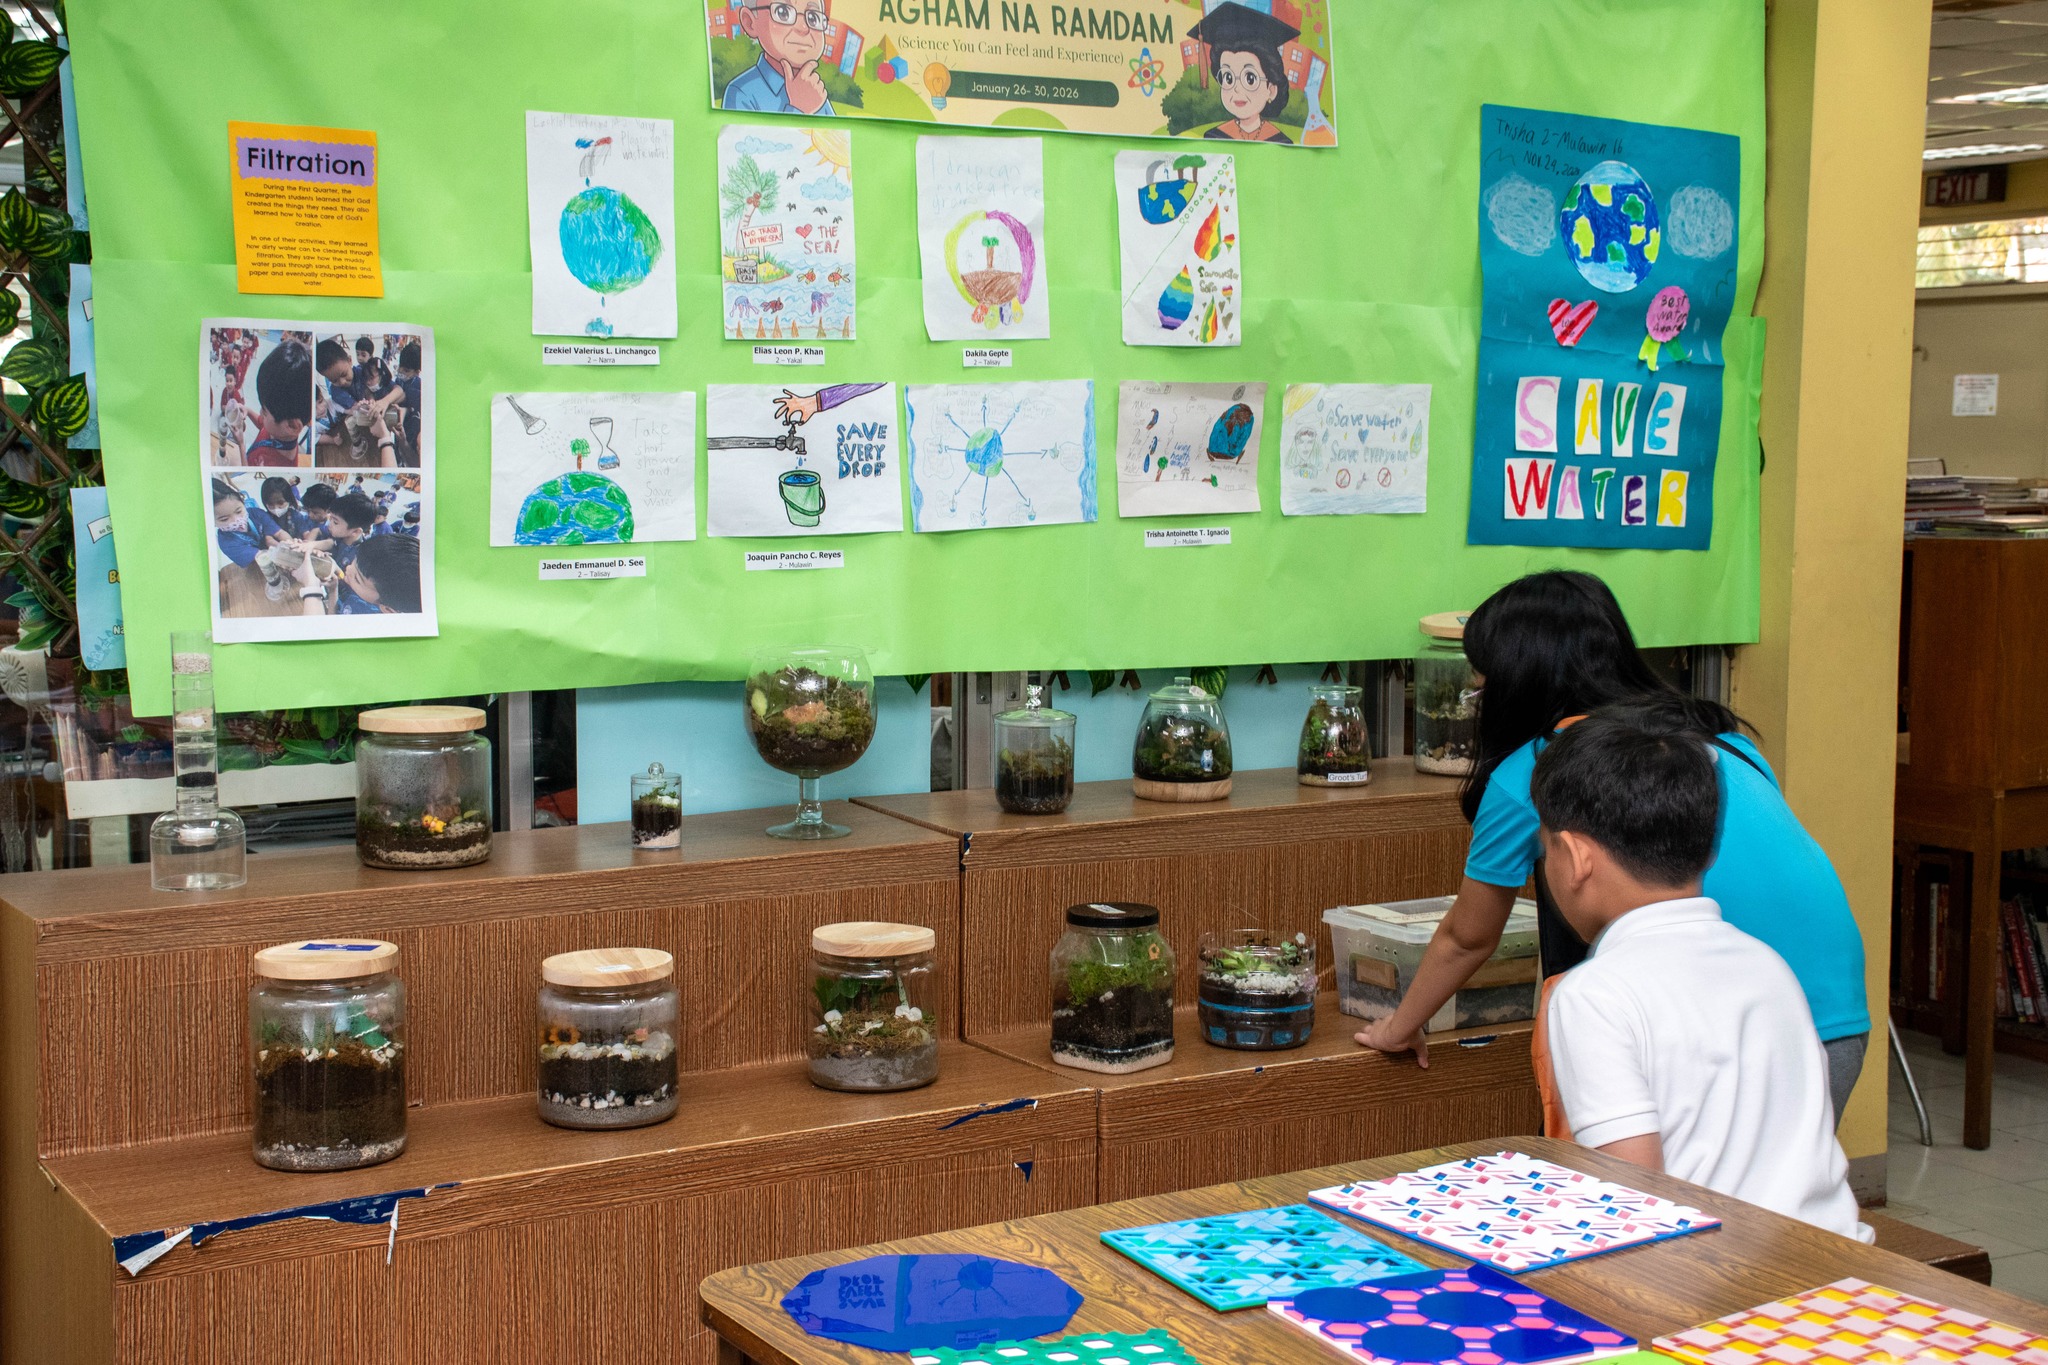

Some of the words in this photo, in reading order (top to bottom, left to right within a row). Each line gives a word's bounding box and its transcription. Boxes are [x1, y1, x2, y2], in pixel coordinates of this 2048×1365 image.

[879, 0, 990, 30] AGHAM
[1002, 2, 1040, 34] NA
[1053, 7, 1174, 44] RAMDAM
[898, 35, 950, 51] (Science
[952, 40, 975, 53] You
[978, 42, 1002, 55] Can
[1006, 43, 1029, 58] Feel
[1032, 46, 1054, 59] and
[1058, 48, 1124, 66] Experience)
[972, 82, 1010, 97] January
[1014, 84, 1030, 95] 26-
[1034, 86, 1050, 98] 30,
[1054, 86, 1079, 98] 2026
[1496, 118, 1535, 144] Trisha
[248, 147, 365, 176] Filtration
[1936, 173, 1980, 205] EXIT
[744, 230, 755, 238] NO
[818, 225, 838, 238] THE
[804, 240, 839, 255] SEA!
[1661, 294, 1686, 308] Best
[1653, 321, 1684, 332] Award
[615, 348, 656, 356] Linchangco
[989, 350, 1008, 358] Gepte
[1334, 403, 1364, 428] Save
[1366, 412, 1402, 430] water
[1518, 378, 1674, 451] SAVE
[632, 418, 671, 438] Take
[837, 422, 888, 442] SAVE
[837, 442, 885, 461] EVERY
[1330, 440, 1359, 463] Save
[649, 467, 669, 476] and
[839, 461, 886, 479] DROP
[1507, 459, 1687, 526] WATER
[1207, 529, 1229, 537] Ignacio
[575, 560, 616, 569] Emmanuel
[747, 553, 777, 562] Joaquin
[819, 551, 841, 559] Reyes
